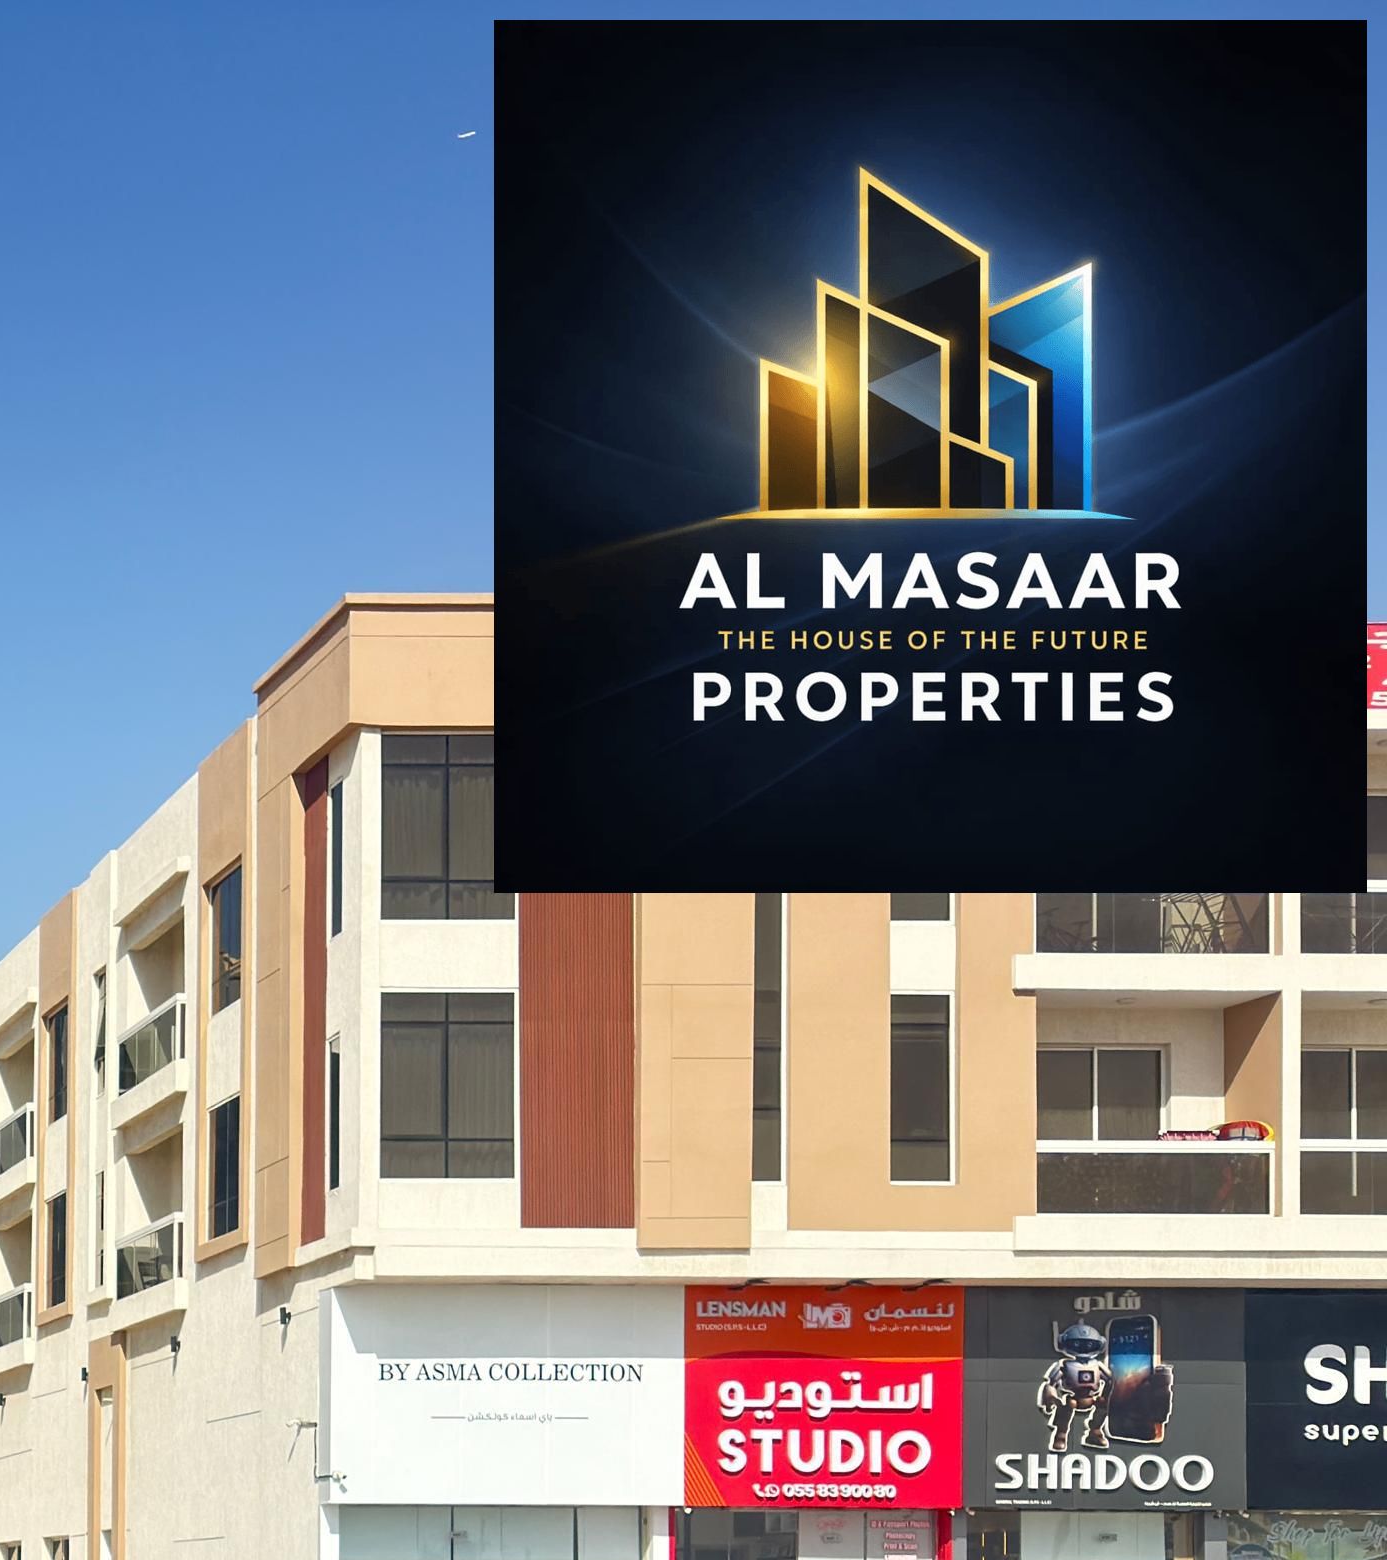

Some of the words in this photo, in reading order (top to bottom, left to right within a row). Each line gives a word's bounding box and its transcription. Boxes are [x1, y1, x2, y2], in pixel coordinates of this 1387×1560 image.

[695, 1300, 787, 1318] LENSMAN
[864, 1302, 955, 1322] لنسمان
[1074, 1289, 1141, 1314] شادو
[379, 1363, 411, 1381] BY
[416, 1363, 482, 1381] ASMA
[488, 1363, 643, 1382] COLLECTION
[718, 1371, 933, 1422] استوديو
[717, 1428, 932, 1475] STUDIO
[994, 1453, 1215, 1492] SHADOO
[782, 1483, 815, 1499] 055
[1267, 1519, 1315, 1545] Shop
